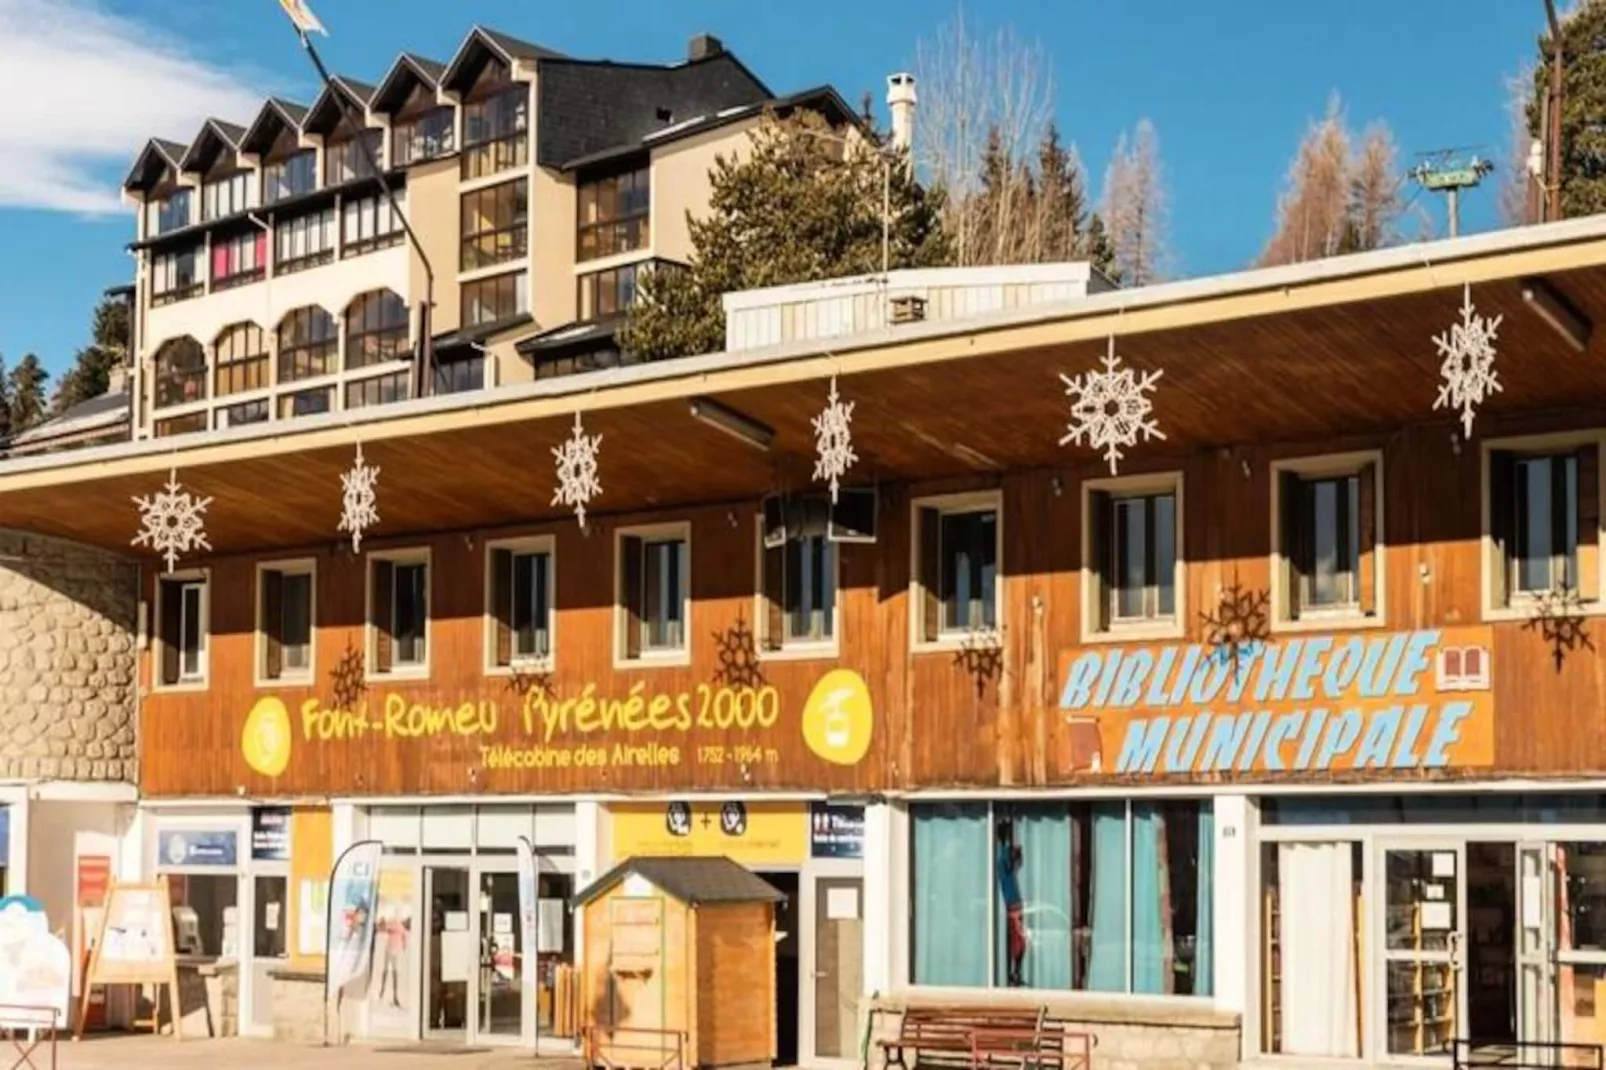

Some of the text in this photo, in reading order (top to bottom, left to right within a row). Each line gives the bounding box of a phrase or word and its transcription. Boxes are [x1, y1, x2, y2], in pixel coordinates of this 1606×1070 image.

[1059, 629, 1442, 710] BIBLIOTHEQUE
[301, 693, 497, 741] Font-Romeu
[696, 684, 779, 729] 2000
[1114, 700, 1475, 774] MUNICIPALE
[574, 743, 607, 767] des
[611, 741, 681, 766] Airelles
